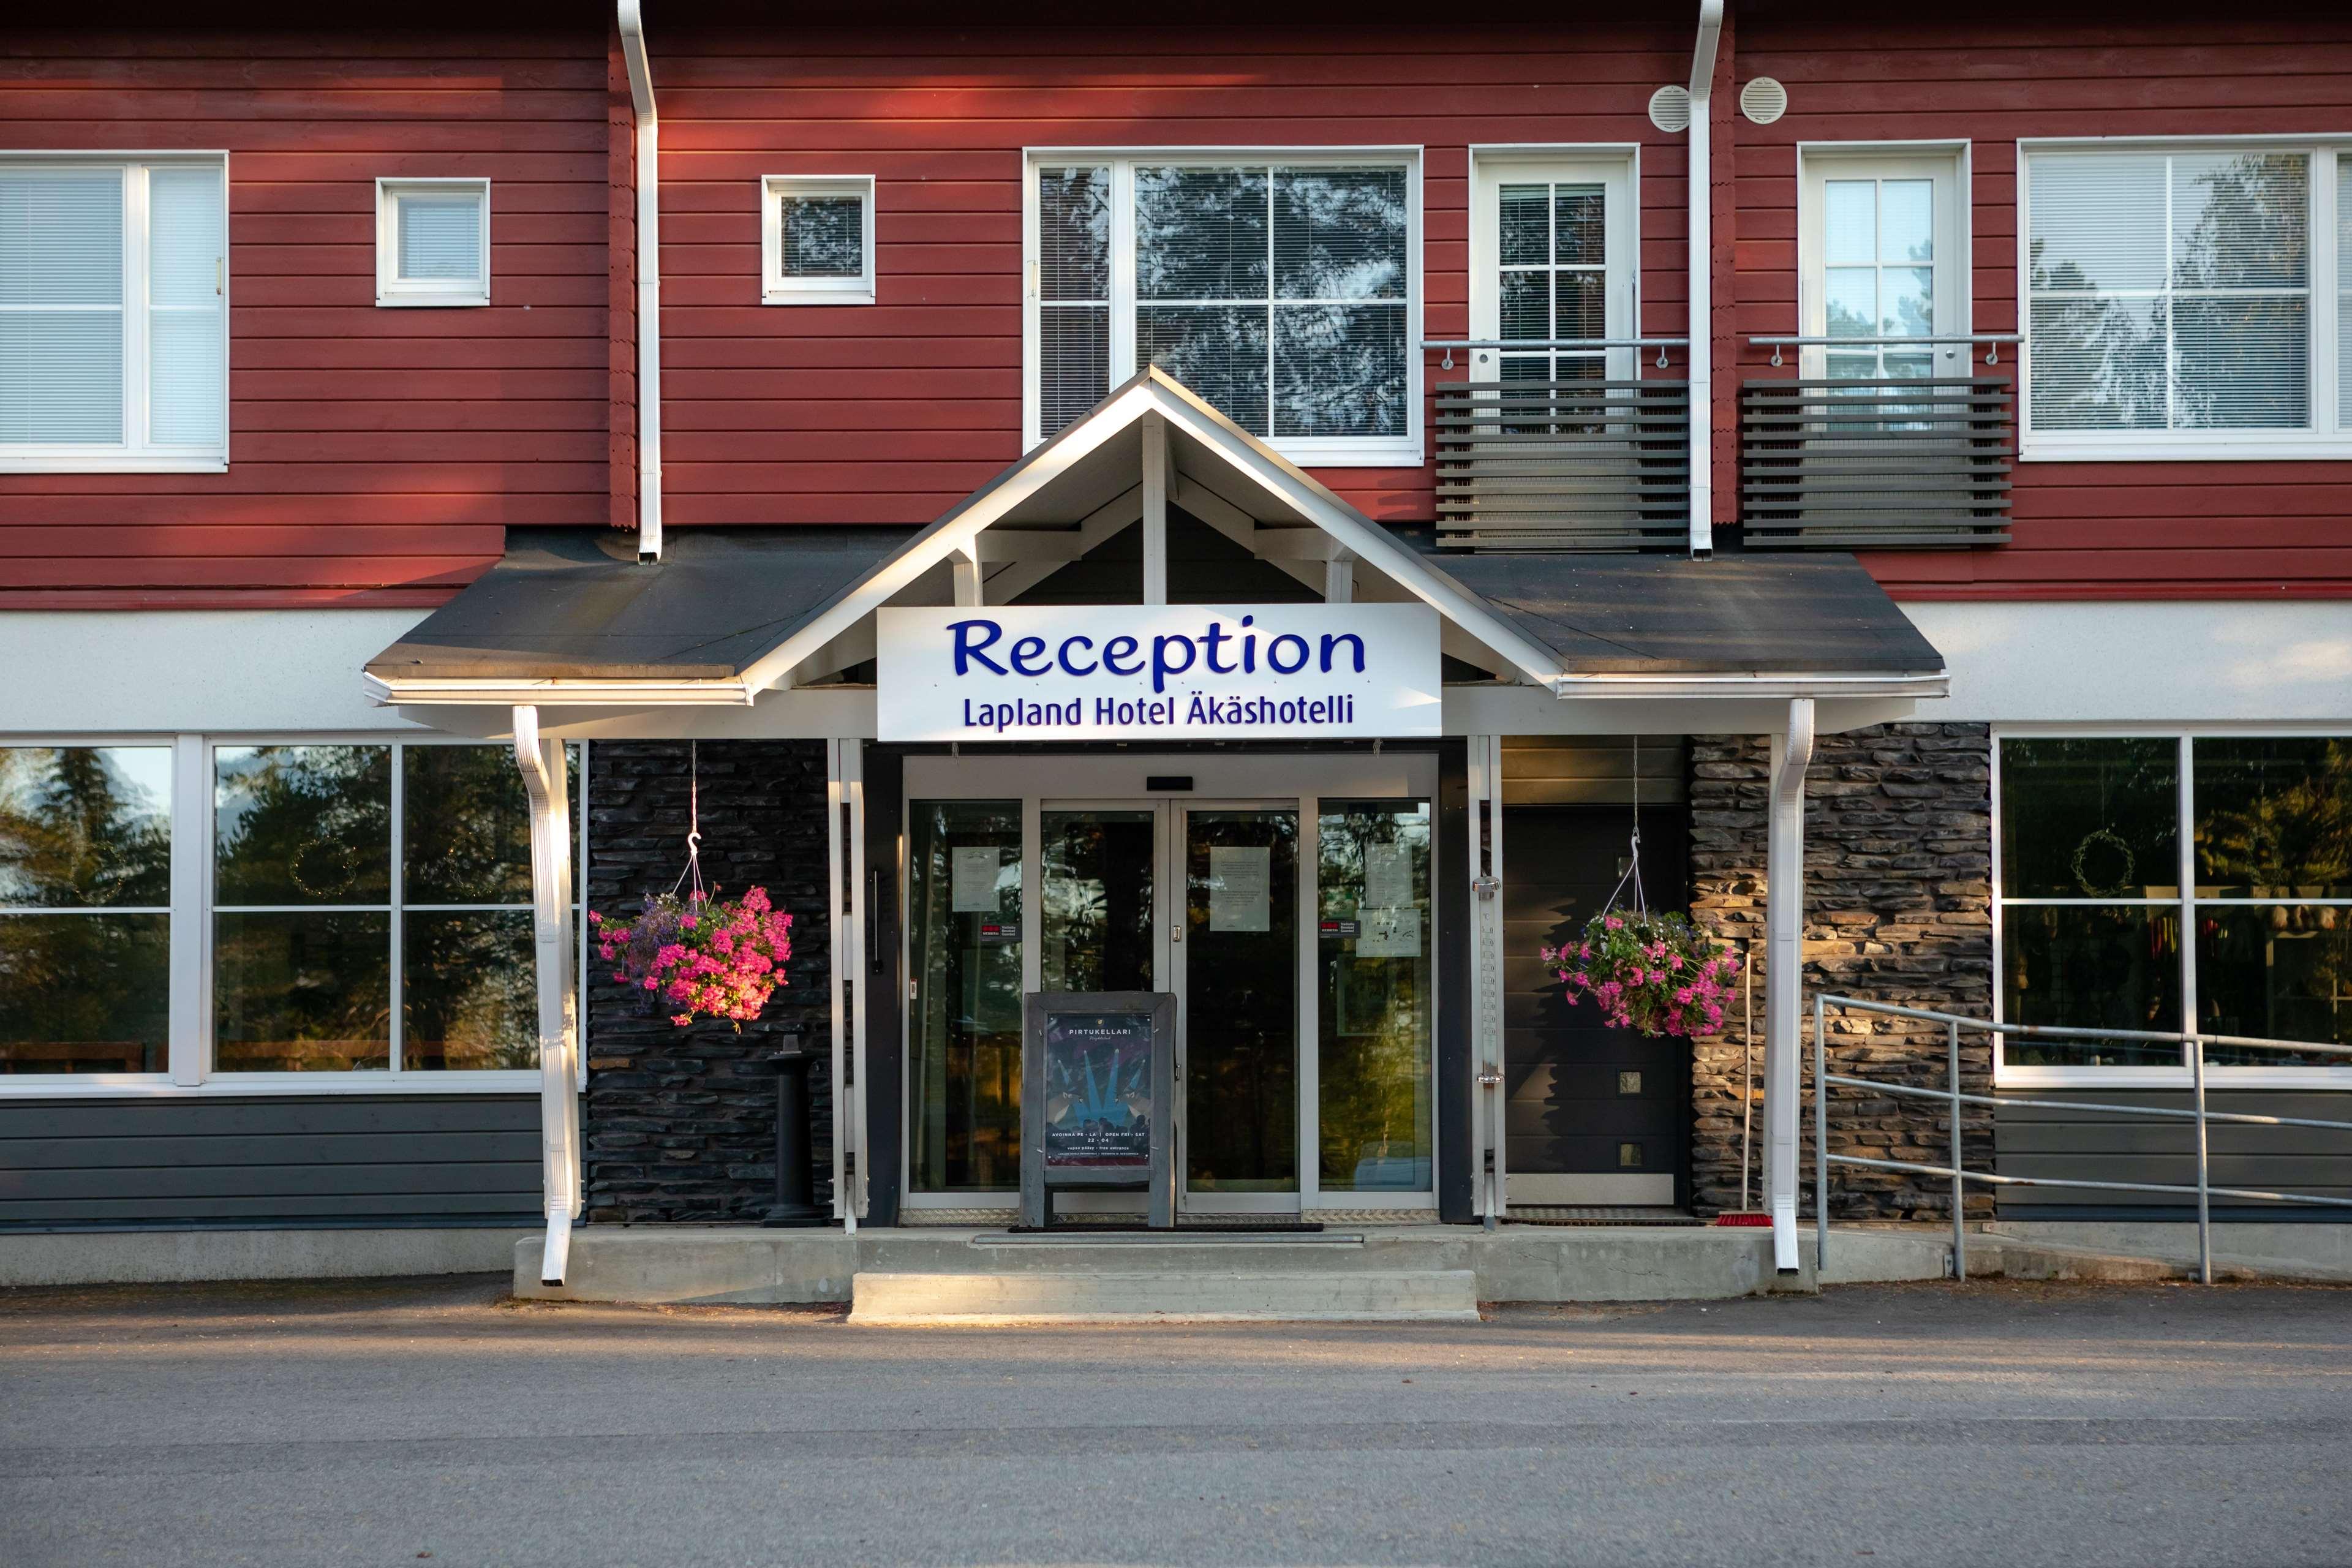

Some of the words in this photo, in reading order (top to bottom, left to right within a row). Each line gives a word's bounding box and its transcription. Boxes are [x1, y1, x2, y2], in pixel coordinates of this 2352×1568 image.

[946, 614, 1365, 694] Reception
[964, 697, 1082, 733] Lapland
[1096, 696, 1175, 725] Hotel
[1187, 690, 1354, 725] Äkäshotelli
